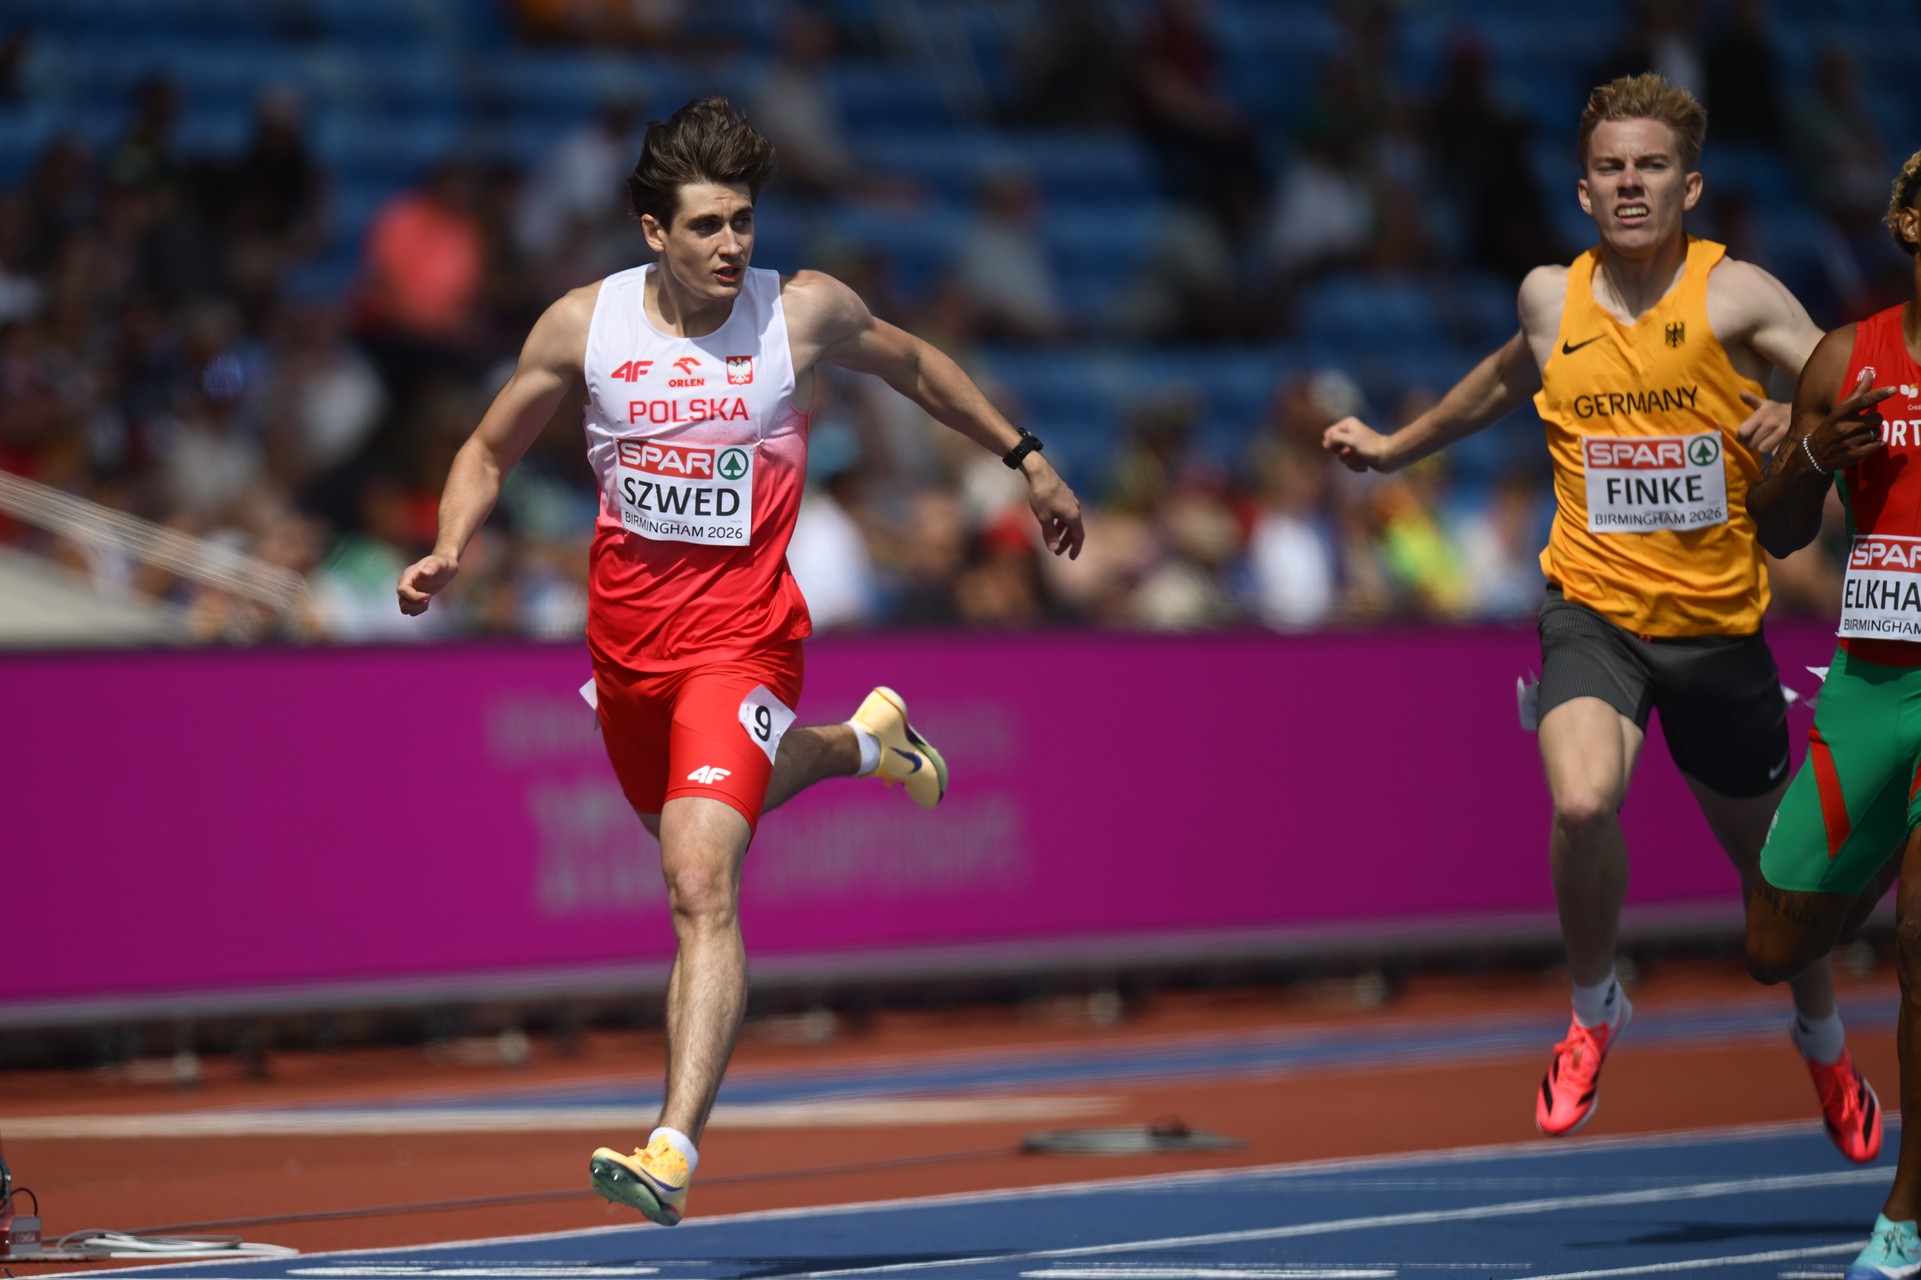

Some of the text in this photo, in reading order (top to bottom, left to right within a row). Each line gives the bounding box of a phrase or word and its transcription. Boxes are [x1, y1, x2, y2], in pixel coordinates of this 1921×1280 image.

[611, 360, 654, 382] 4F
[668, 378, 705, 387] ORLEN
[629, 397, 749, 424] POLSKA
[1574, 385, 1698, 419] GERMANY
[619, 443, 712, 475] SPAR
[1589, 443, 1683, 466] SPAR
[624, 477, 740, 516] SZWED
[1607, 474, 1704, 505] FINKE
[625, 511, 743, 539] BIRMINGHAM 2026
[1595, 507, 1722, 525] BIRMINGHAM 2026
[1845, 579, 1921, 612] ELKHA
[754, 705, 771, 742] 9
[687, 765, 731, 784] 4F
